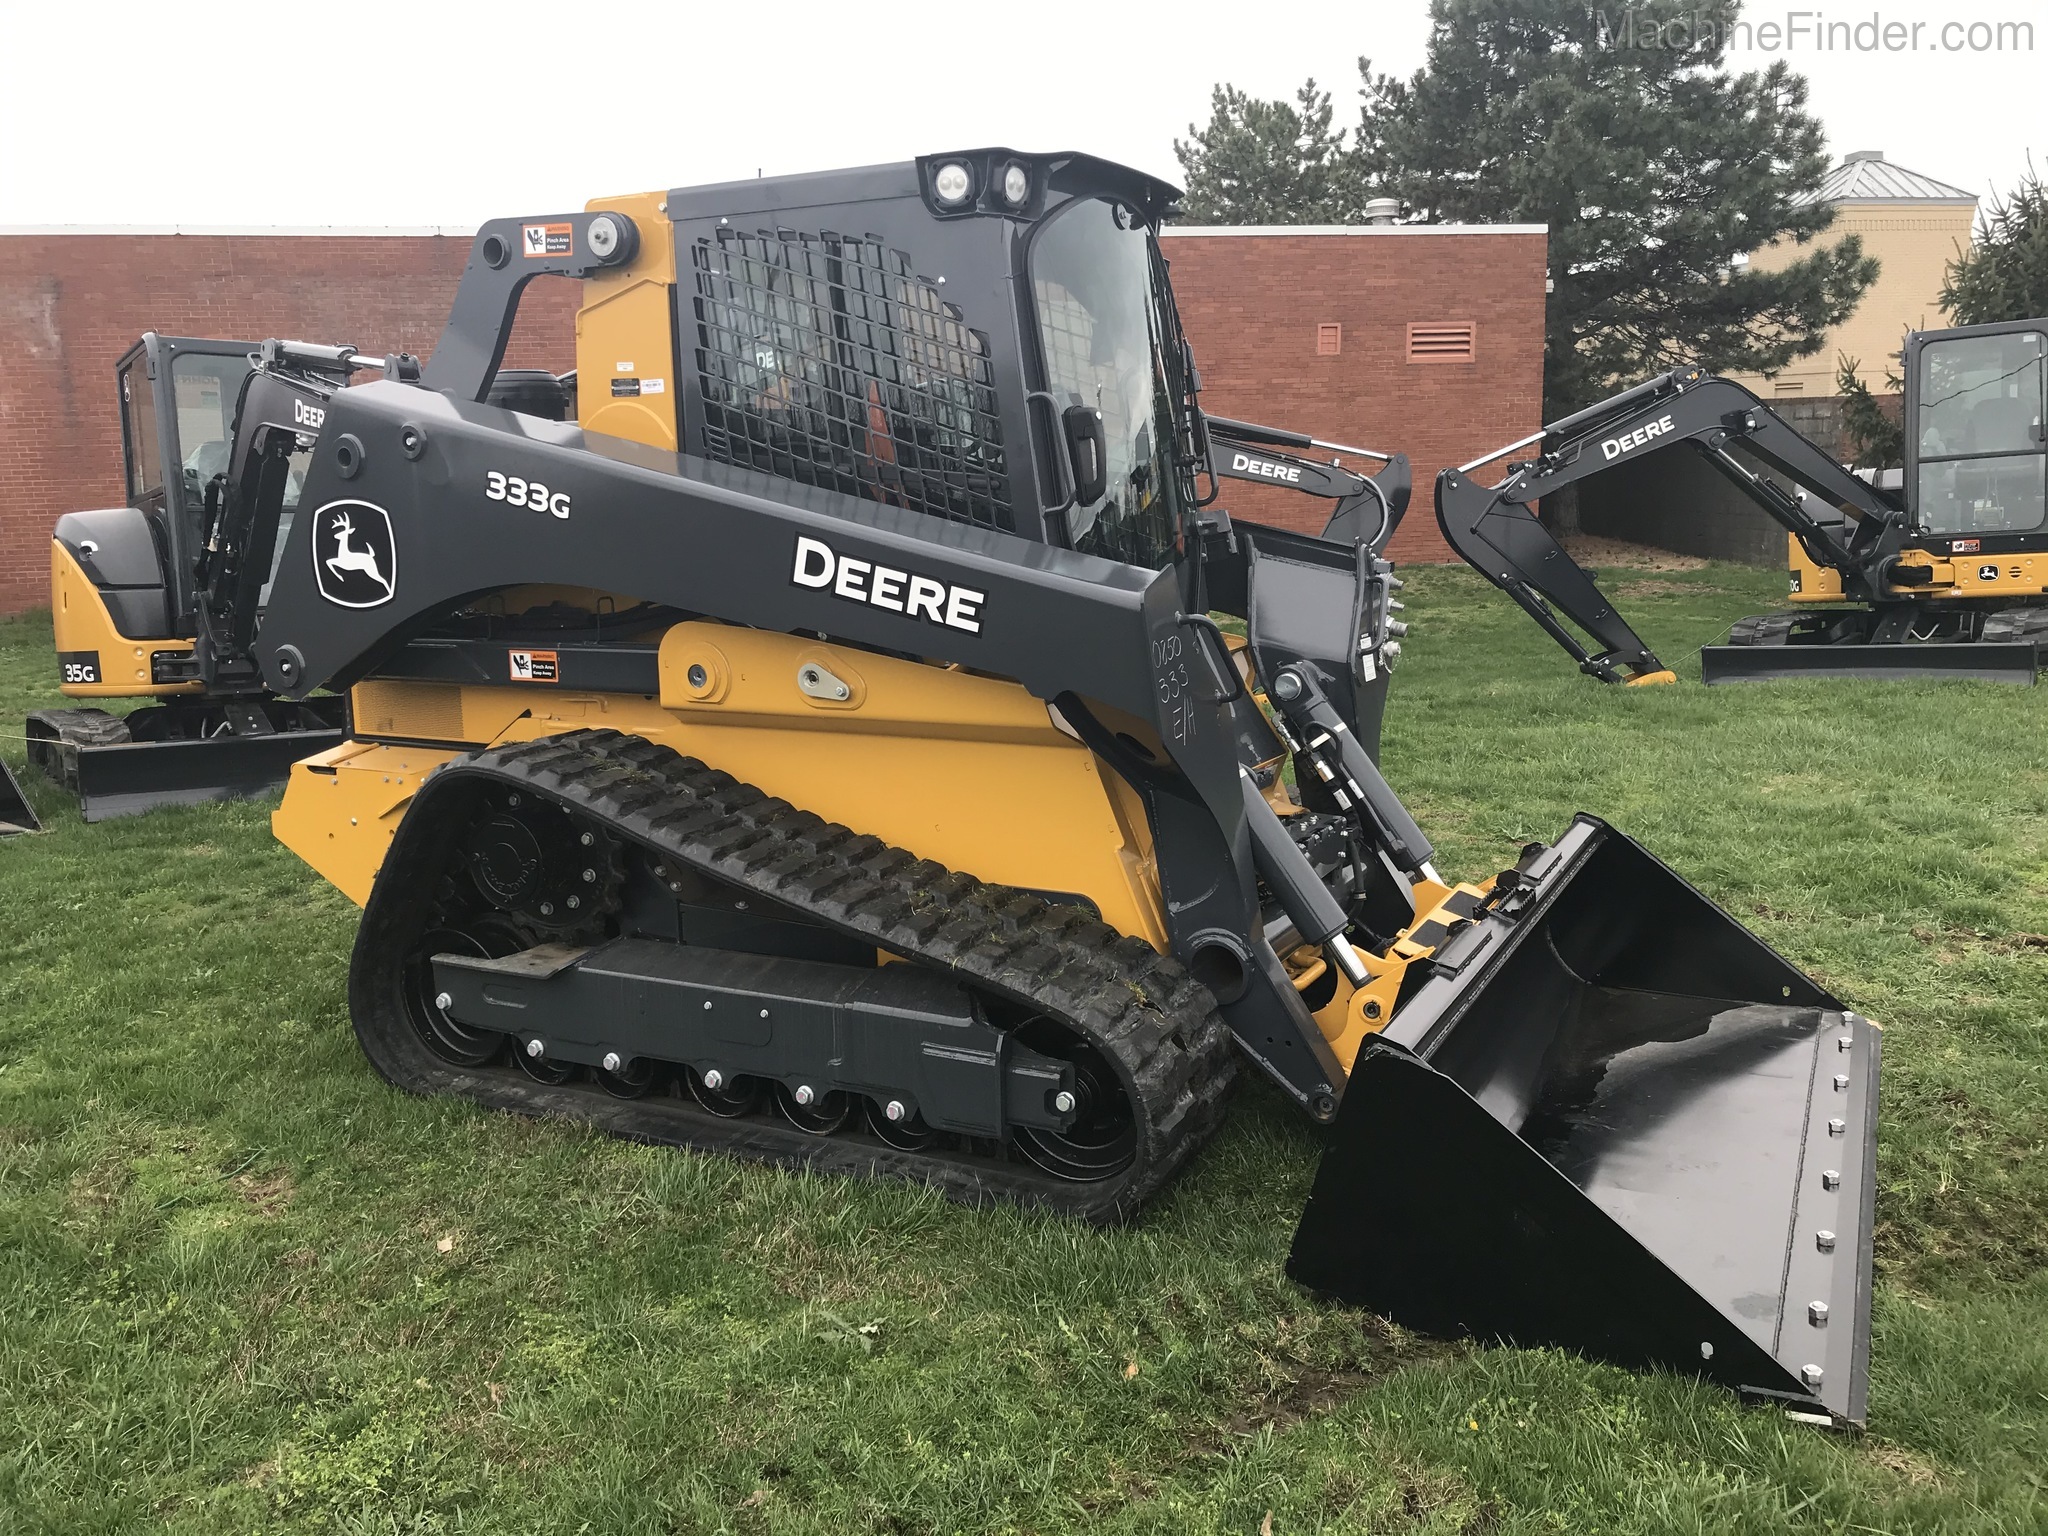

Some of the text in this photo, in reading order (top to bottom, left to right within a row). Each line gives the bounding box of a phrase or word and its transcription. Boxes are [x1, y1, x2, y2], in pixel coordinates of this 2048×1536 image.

[295, 398, 326, 428] DEER
[1600, 414, 1676, 460] DEERE
[1232, 454, 1301, 483] DEERE
[486, 471, 571, 519] 333G
[793, 536, 985, 633] DEERE
[65, 663, 95, 683] 35G
[1158, 663, 1189, 704] 333
